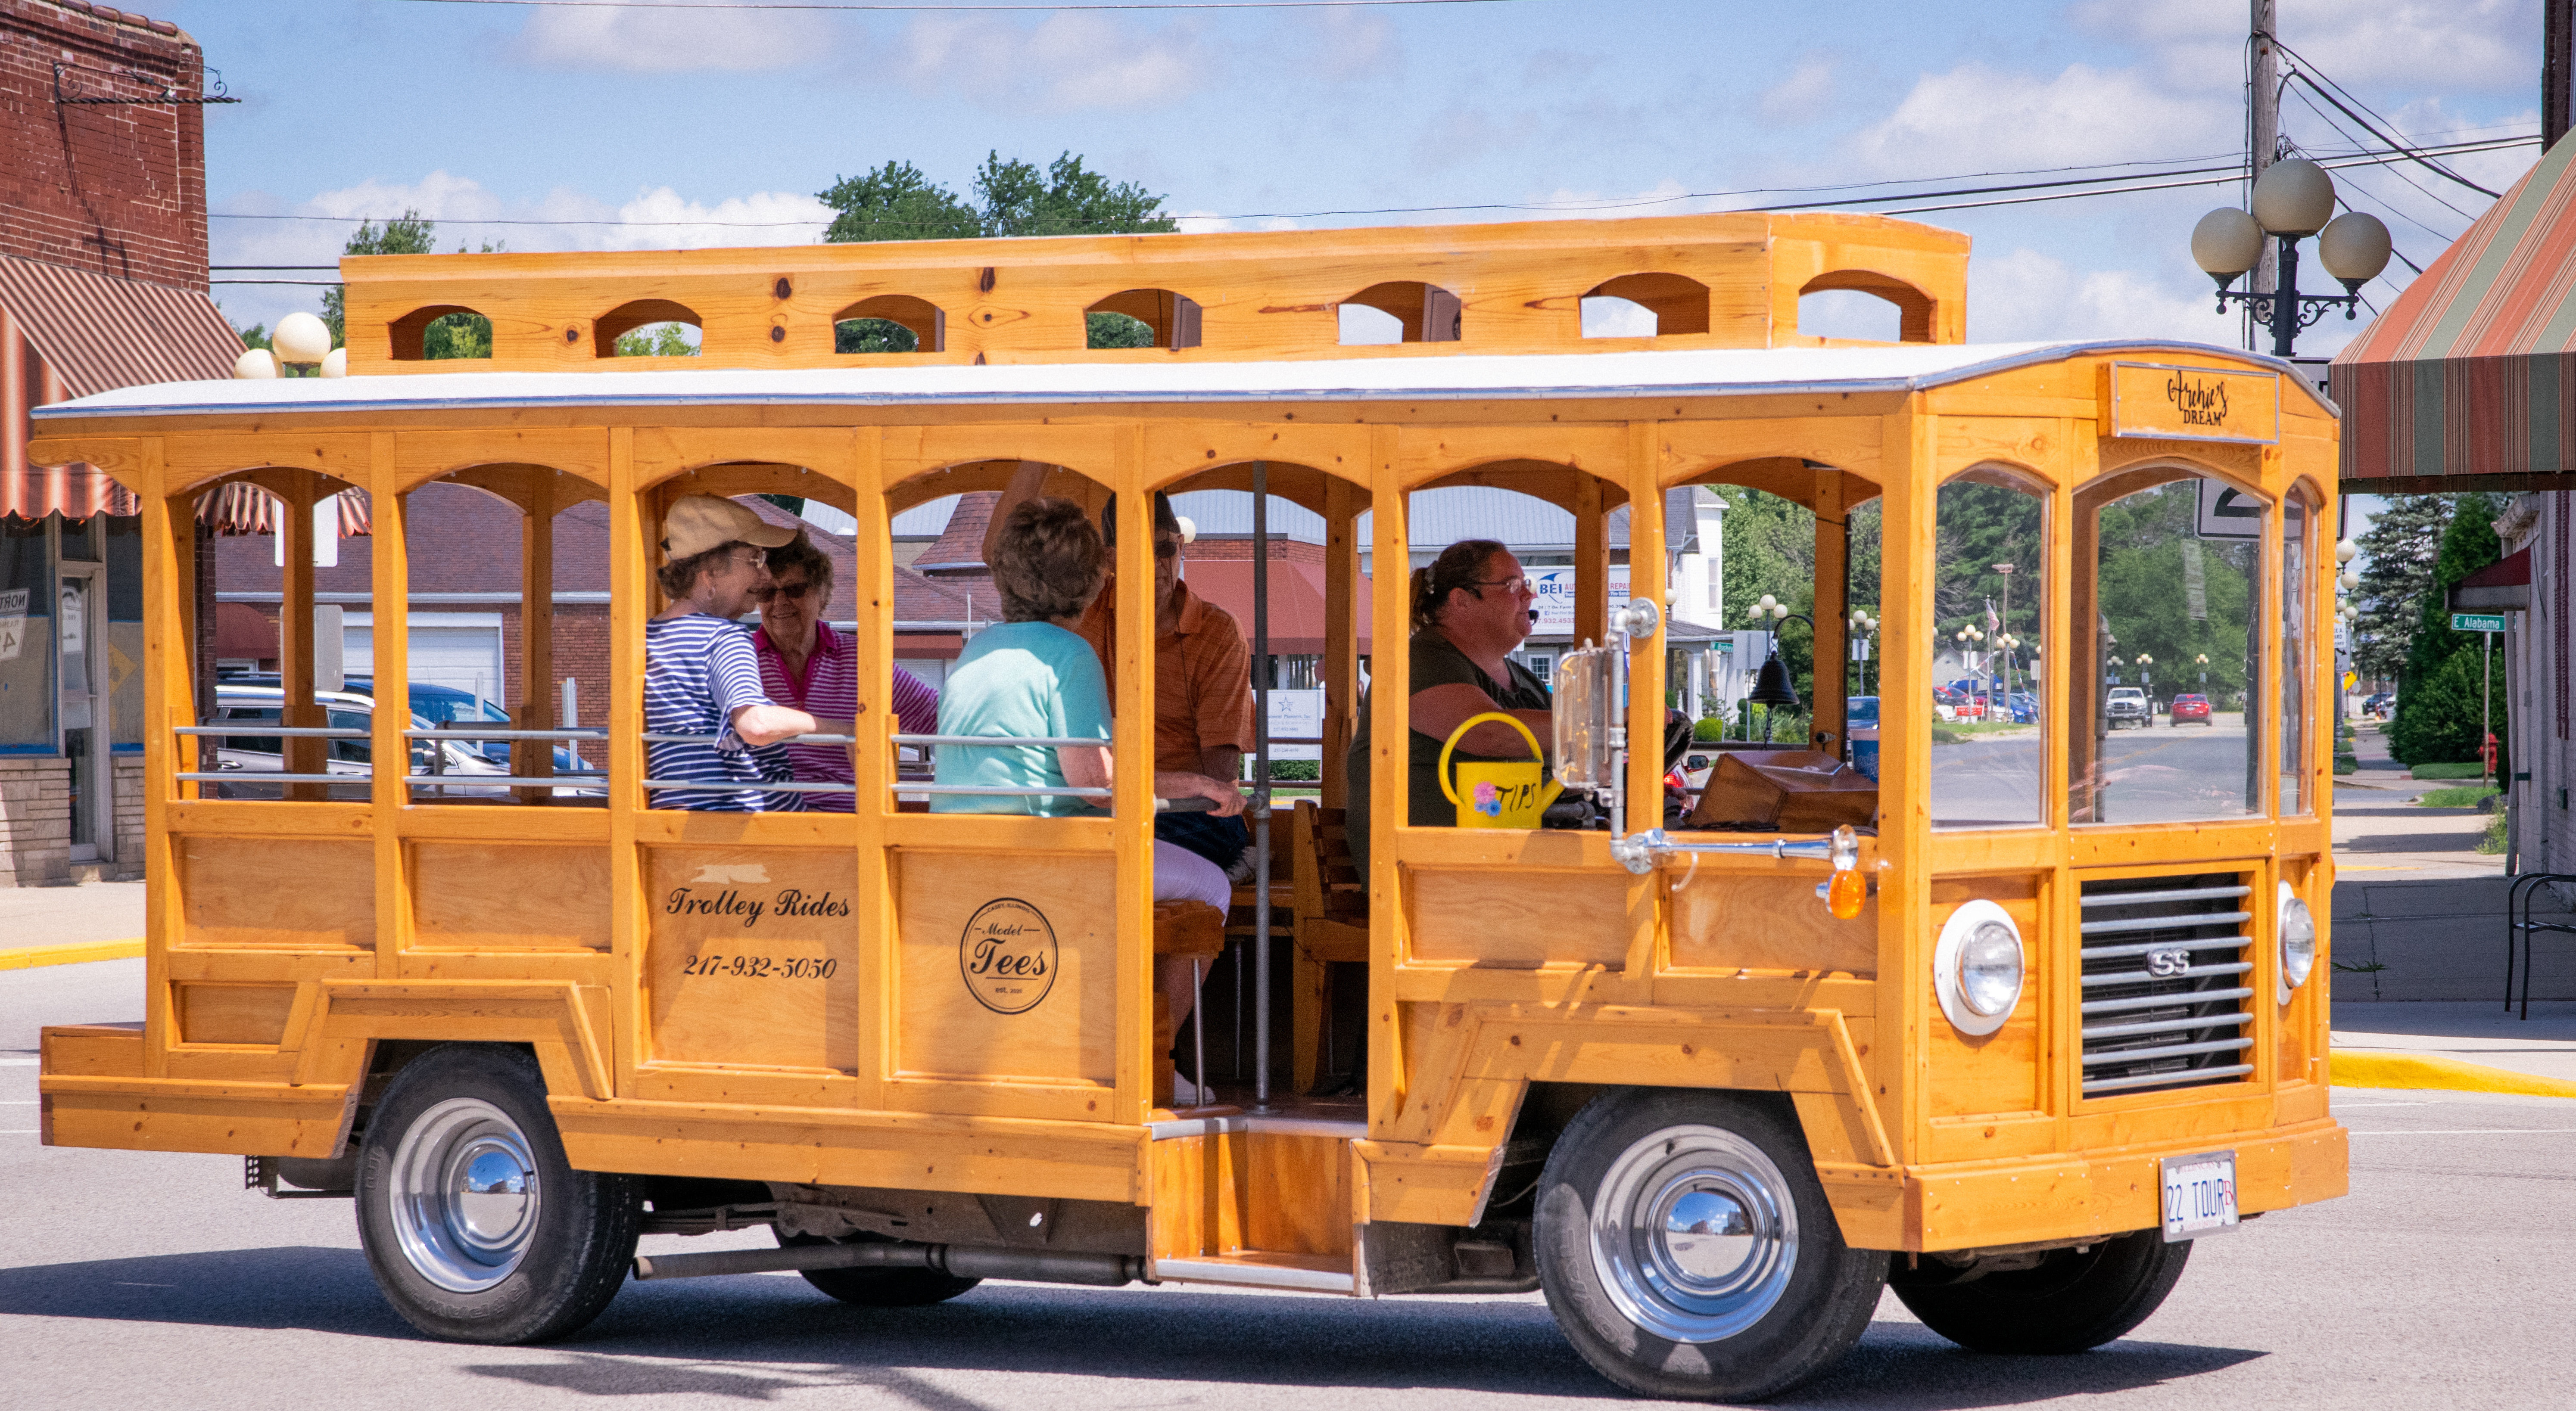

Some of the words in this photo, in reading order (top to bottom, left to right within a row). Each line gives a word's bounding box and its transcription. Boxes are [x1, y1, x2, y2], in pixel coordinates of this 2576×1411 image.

[2168, 370, 2229, 417] Archie's
[2184, 409, 2222, 426] DREAM
[1540, 584, 1562, 594] BEI
[2454, 616, 2459, 628] E
[2464, 617, 2500, 629] Alabama
[1495, 783, 1537, 812] TIPS
[667, 887, 765, 928] Trolley
[774, 889, 851, 917] Rides
[982, 922, 1023, 935] Model
[683, 955, 837, 979] 217-932-5050
[970, 938, 1049, 976] Tees
[2152, 949, 2190, 975] SS
[2167, 1184, 2183, 1222] 22
[2192, 1178, 2225, 1219] TOUR
